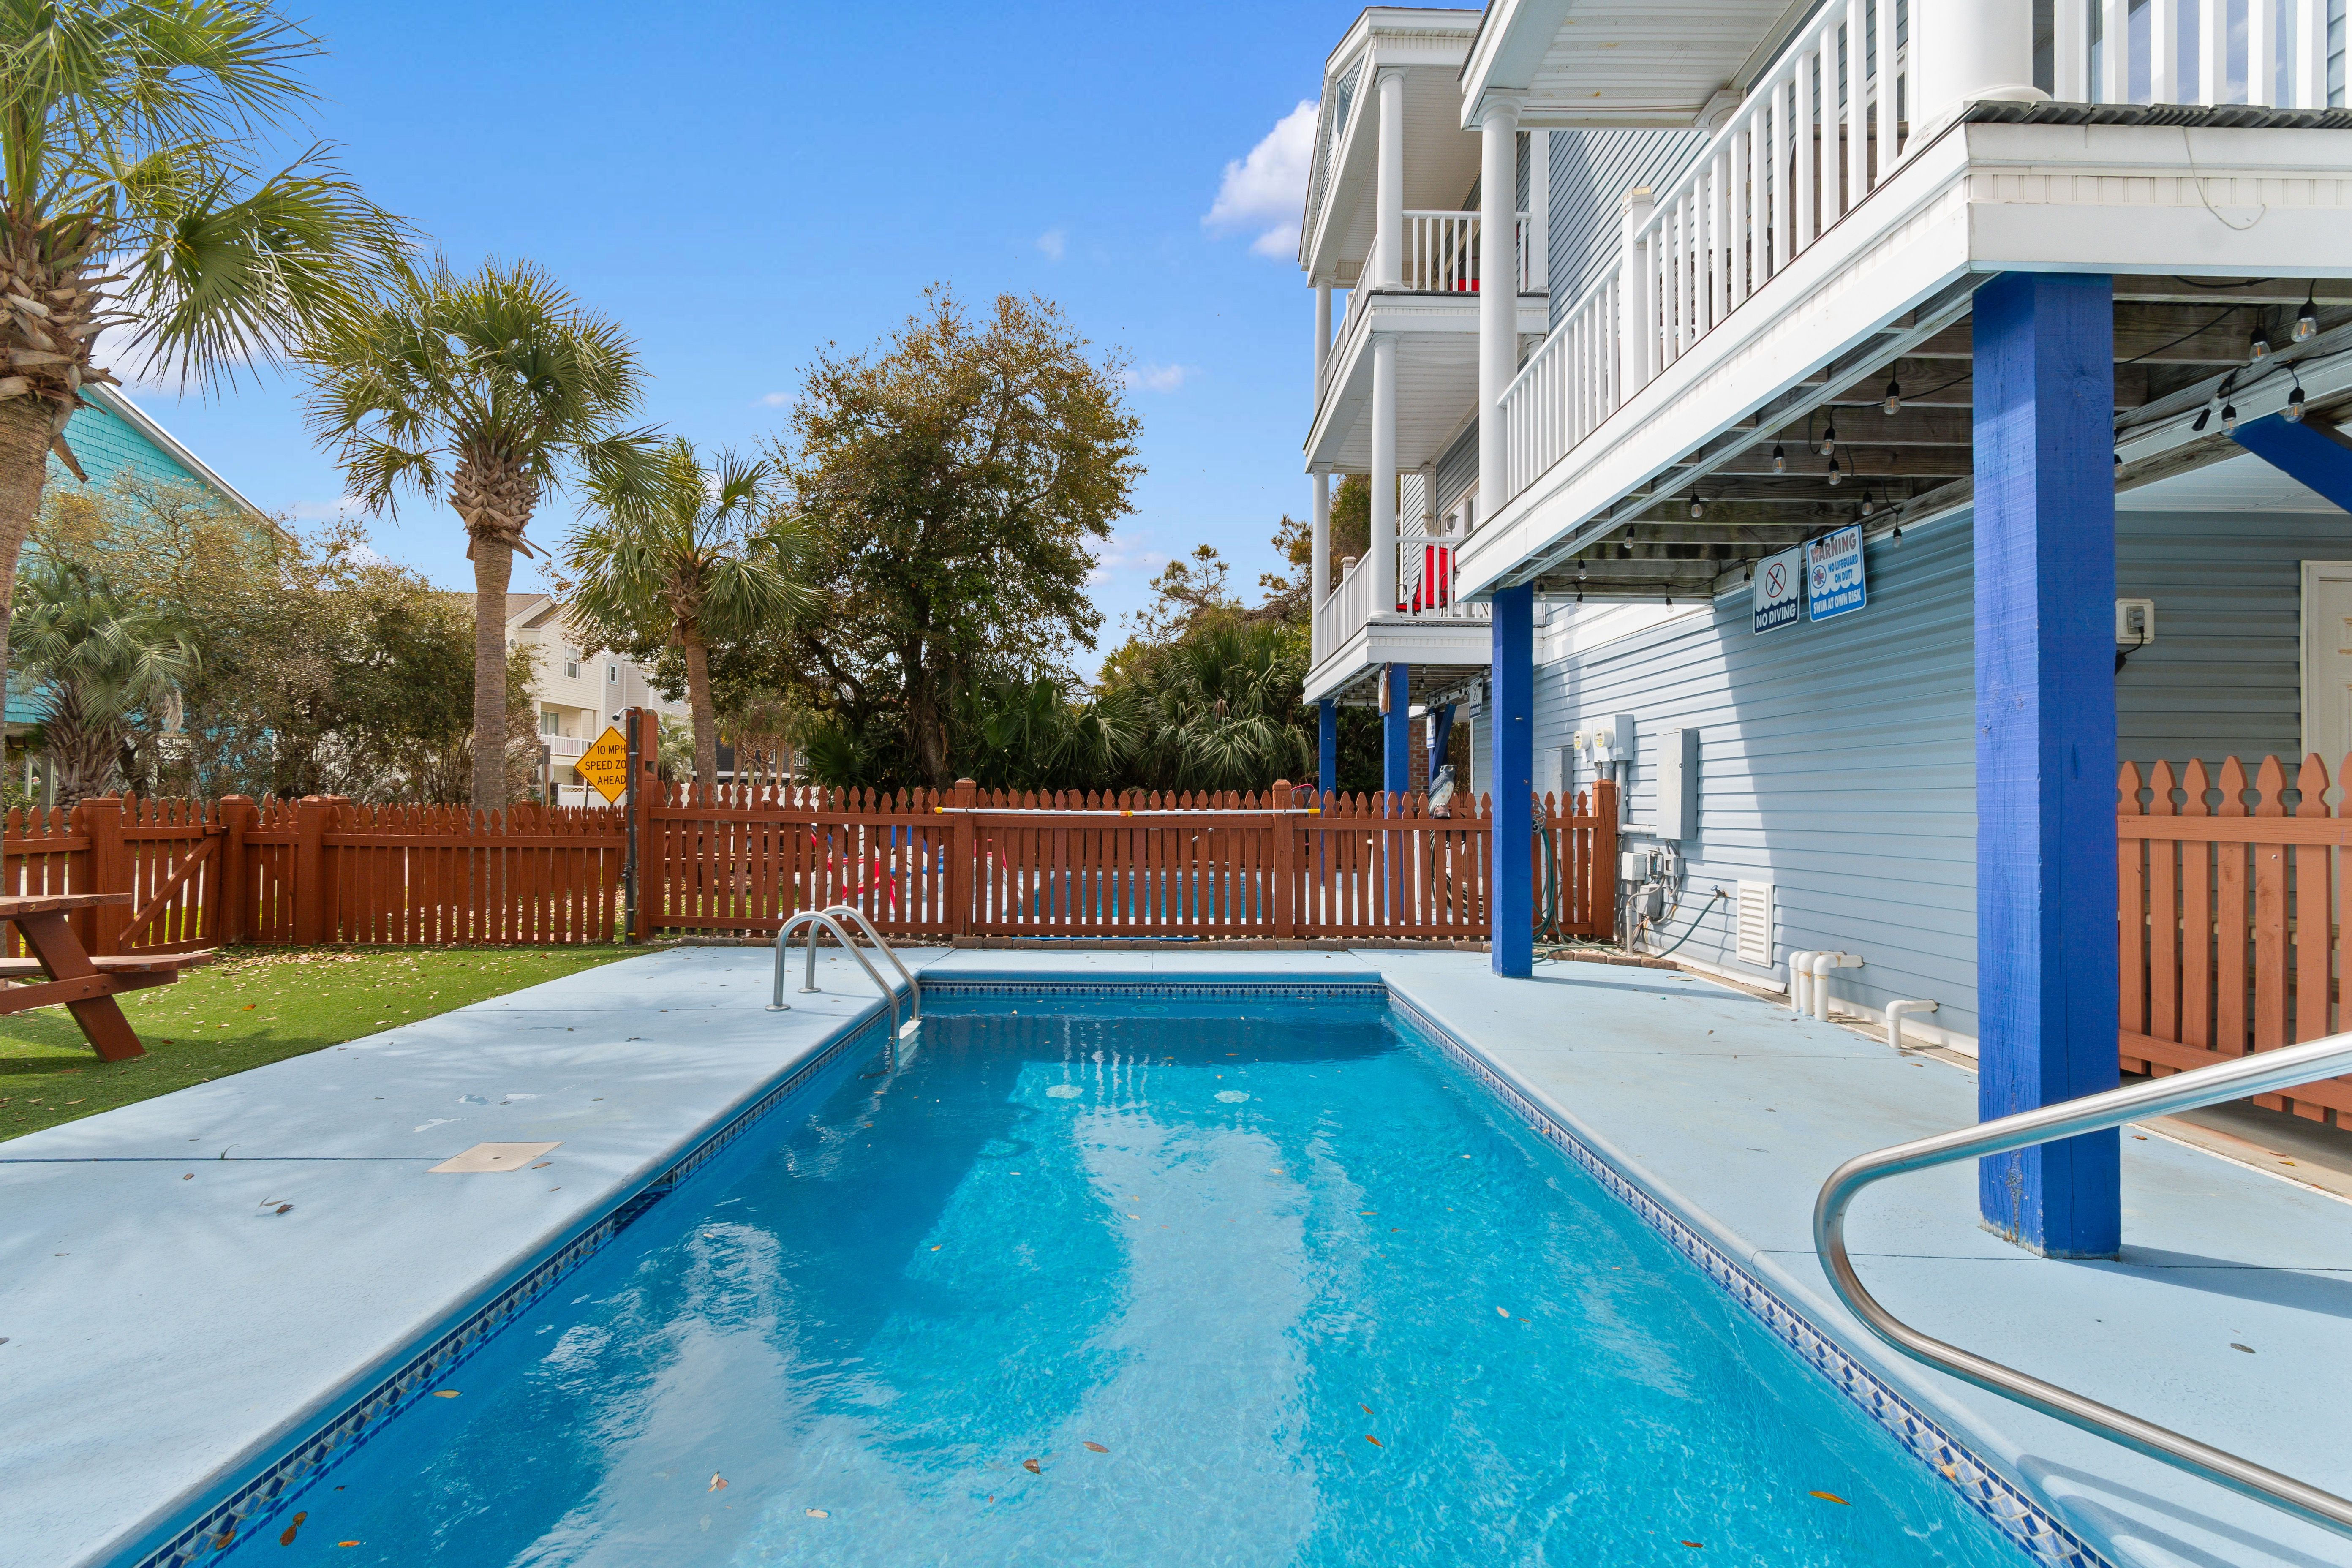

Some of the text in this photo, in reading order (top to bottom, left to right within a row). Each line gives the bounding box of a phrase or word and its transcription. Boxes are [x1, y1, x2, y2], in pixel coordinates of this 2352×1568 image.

[1810, 532, 1856, 564] WARNING
[1828, 554, 1858, 573] NO LIFEGUARD
[1835, 569, 1853, 583] ON DUTY
[1813, 588, 1861, 614] SWIM AT OWN RISK
[1756, 603, 1796, 628] NO DIVING
[597, 744, 626, 755] 10 MPH
[585, 761, 612, 770] SPEED
[597, 776, 626, 785] AHEAD
